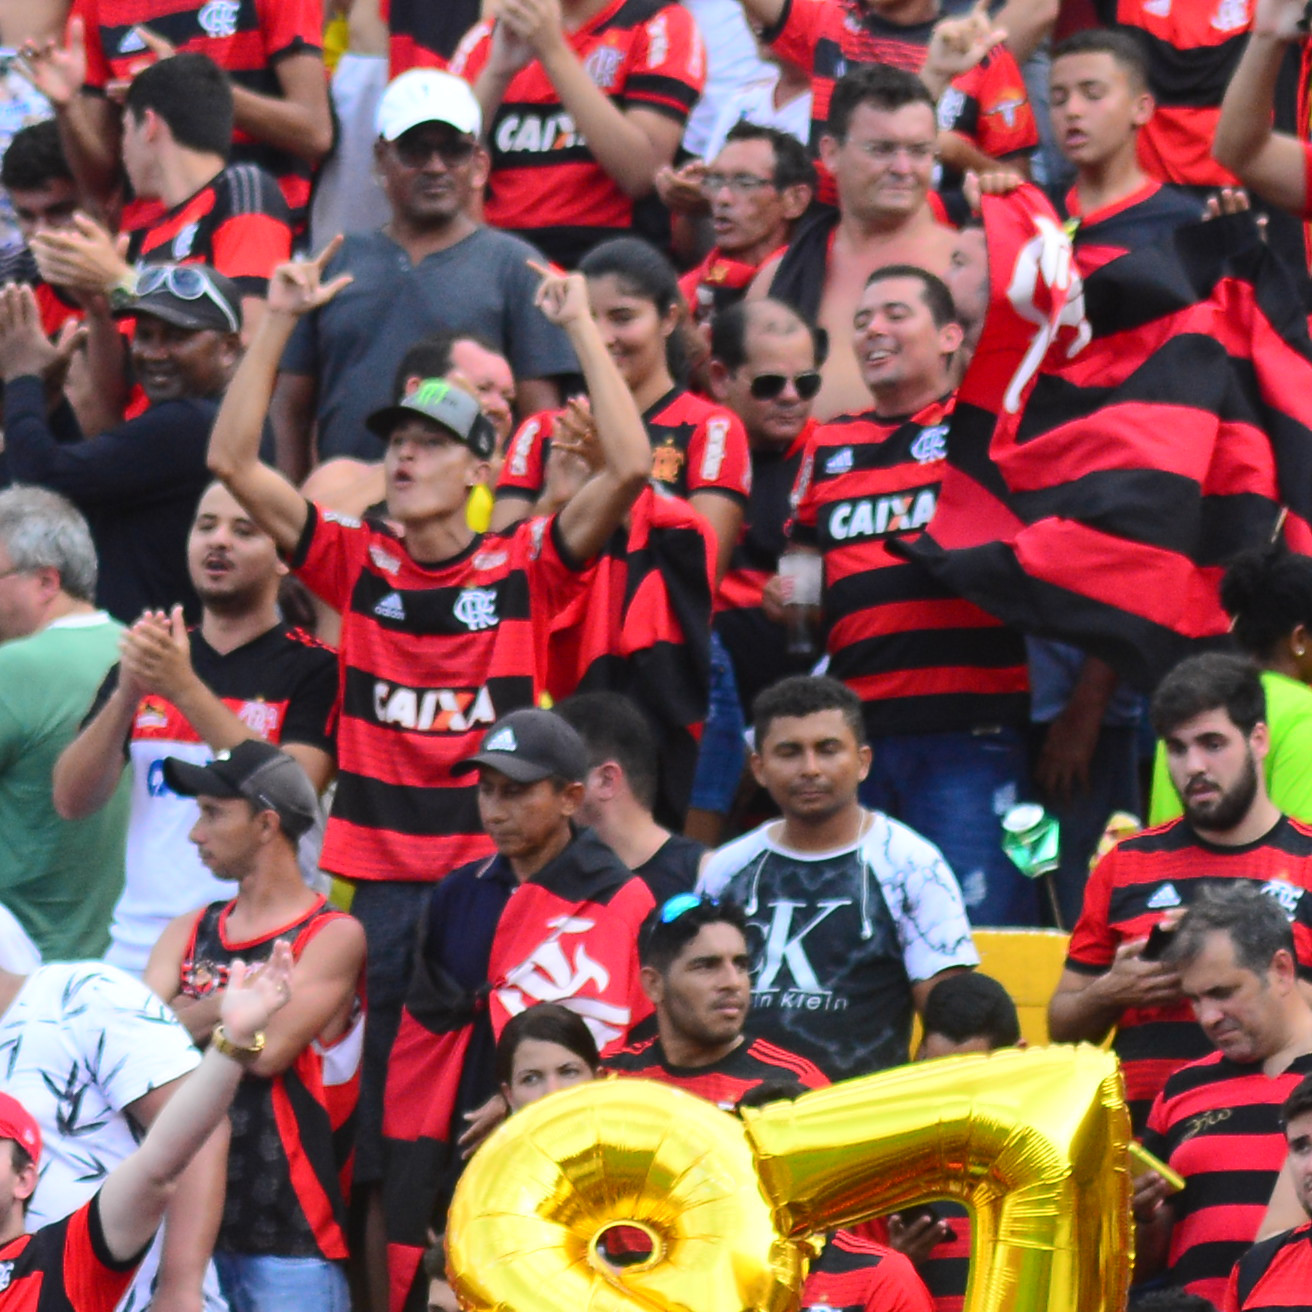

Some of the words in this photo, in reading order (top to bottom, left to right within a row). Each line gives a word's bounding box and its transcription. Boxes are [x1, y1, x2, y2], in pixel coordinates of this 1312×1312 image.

[495, 113, 587, 152] CAIX
[825, 490, 934, 540] CAIXA
[371, 681, 495, 733] CAIXA
